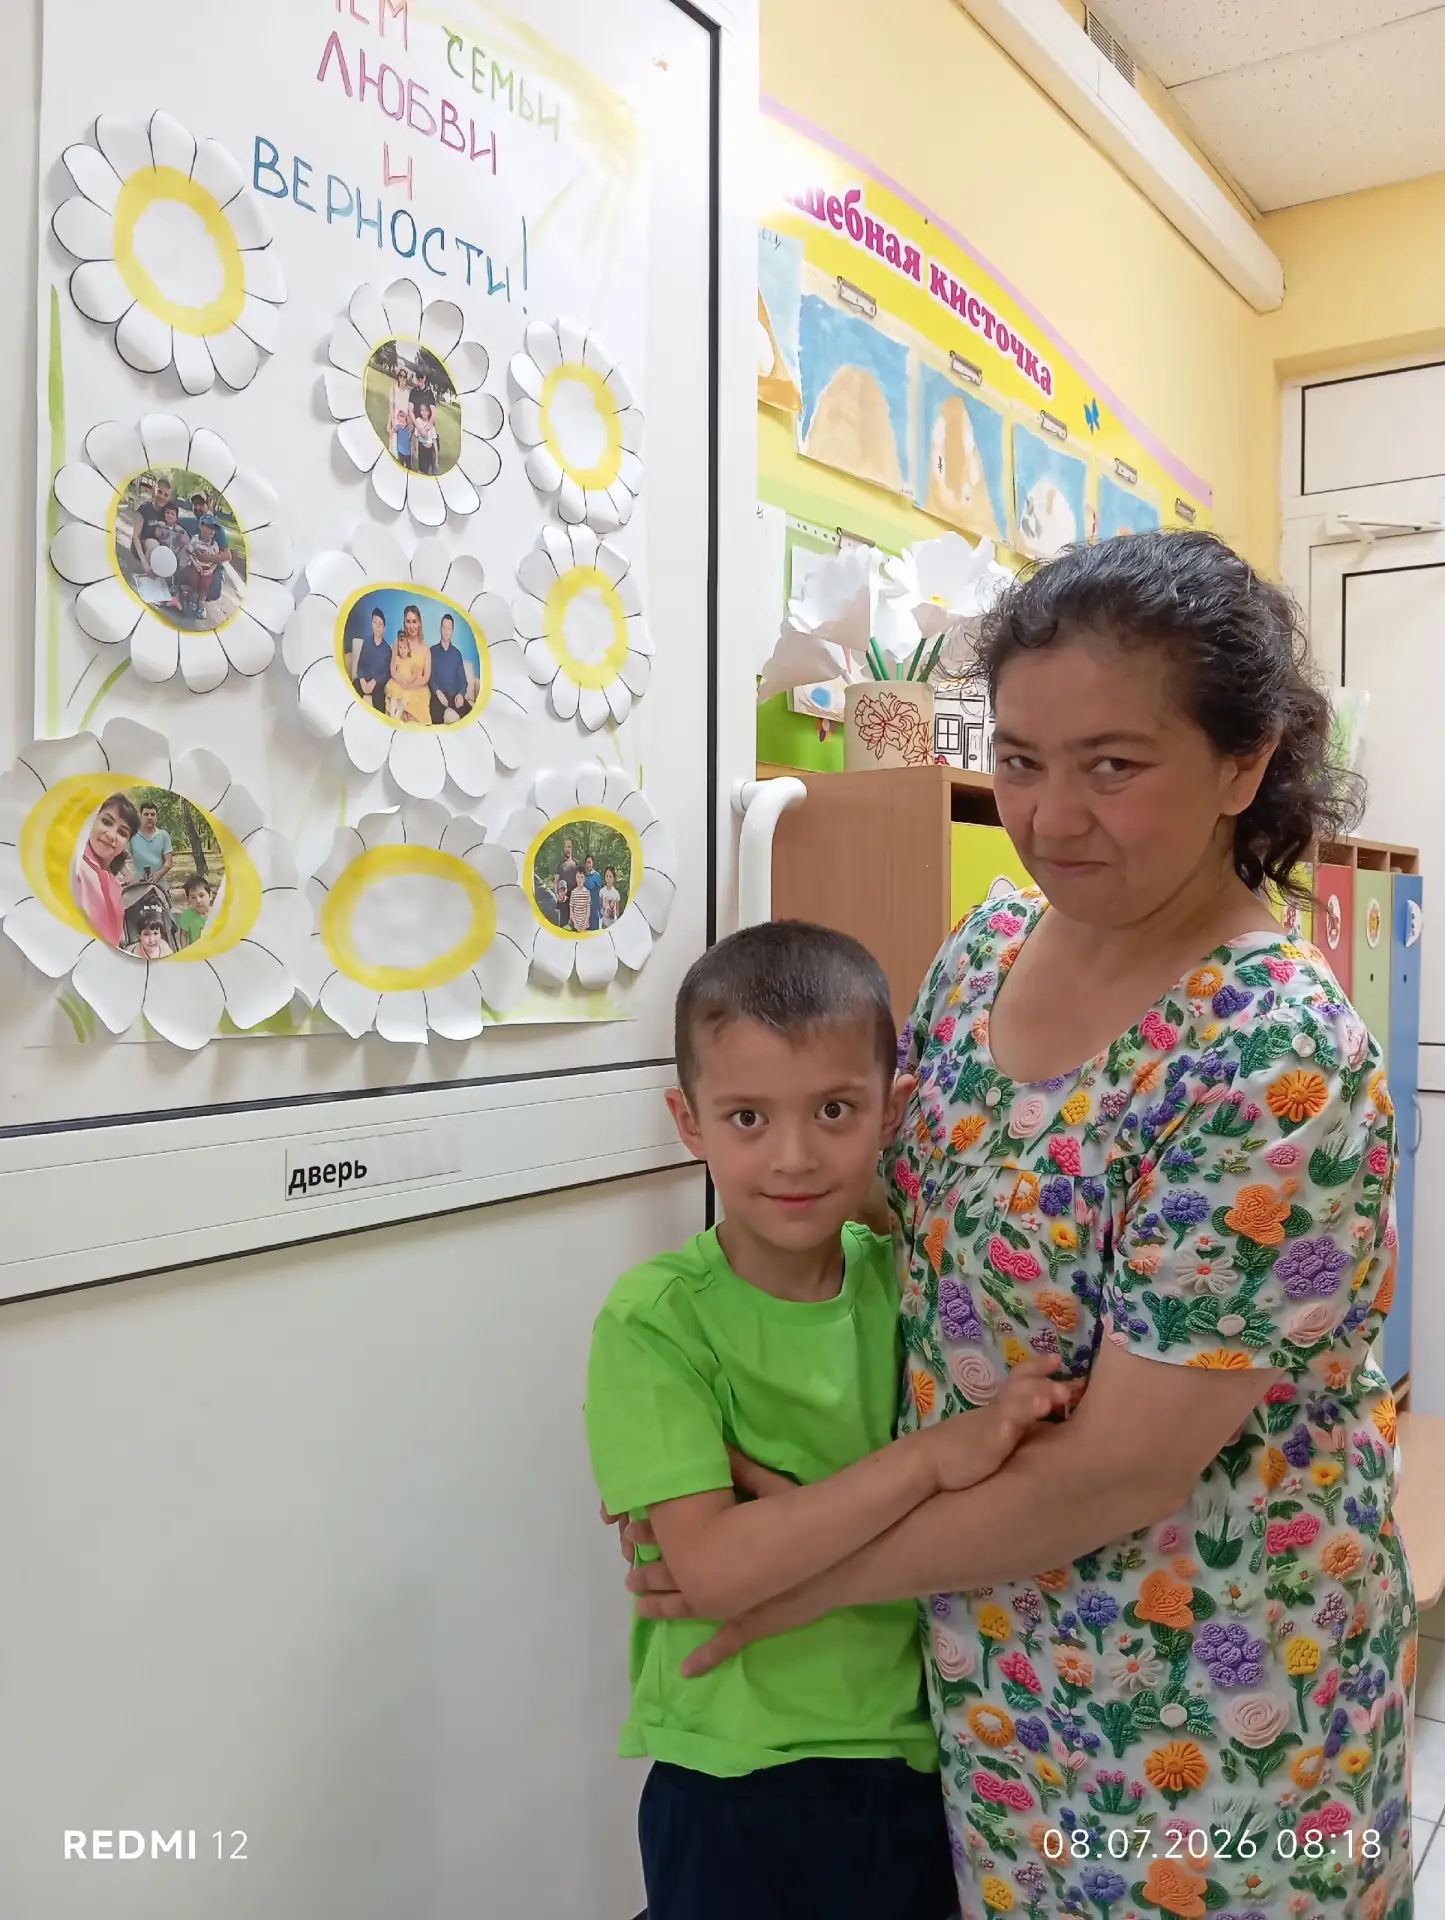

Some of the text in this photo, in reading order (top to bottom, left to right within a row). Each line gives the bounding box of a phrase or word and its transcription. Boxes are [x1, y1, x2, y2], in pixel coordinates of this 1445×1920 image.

[316, 30, 497, 175] ЛЮБВИ
[442, 26, 559, 142] СЕМЬИ
[253, 135, 528, 314] ВЕРНОСТИ!
[383, 142, 413, 200] И
[929, 263, 1051, 395] кисточка
[288, 1159, 368, 1196] дверь
